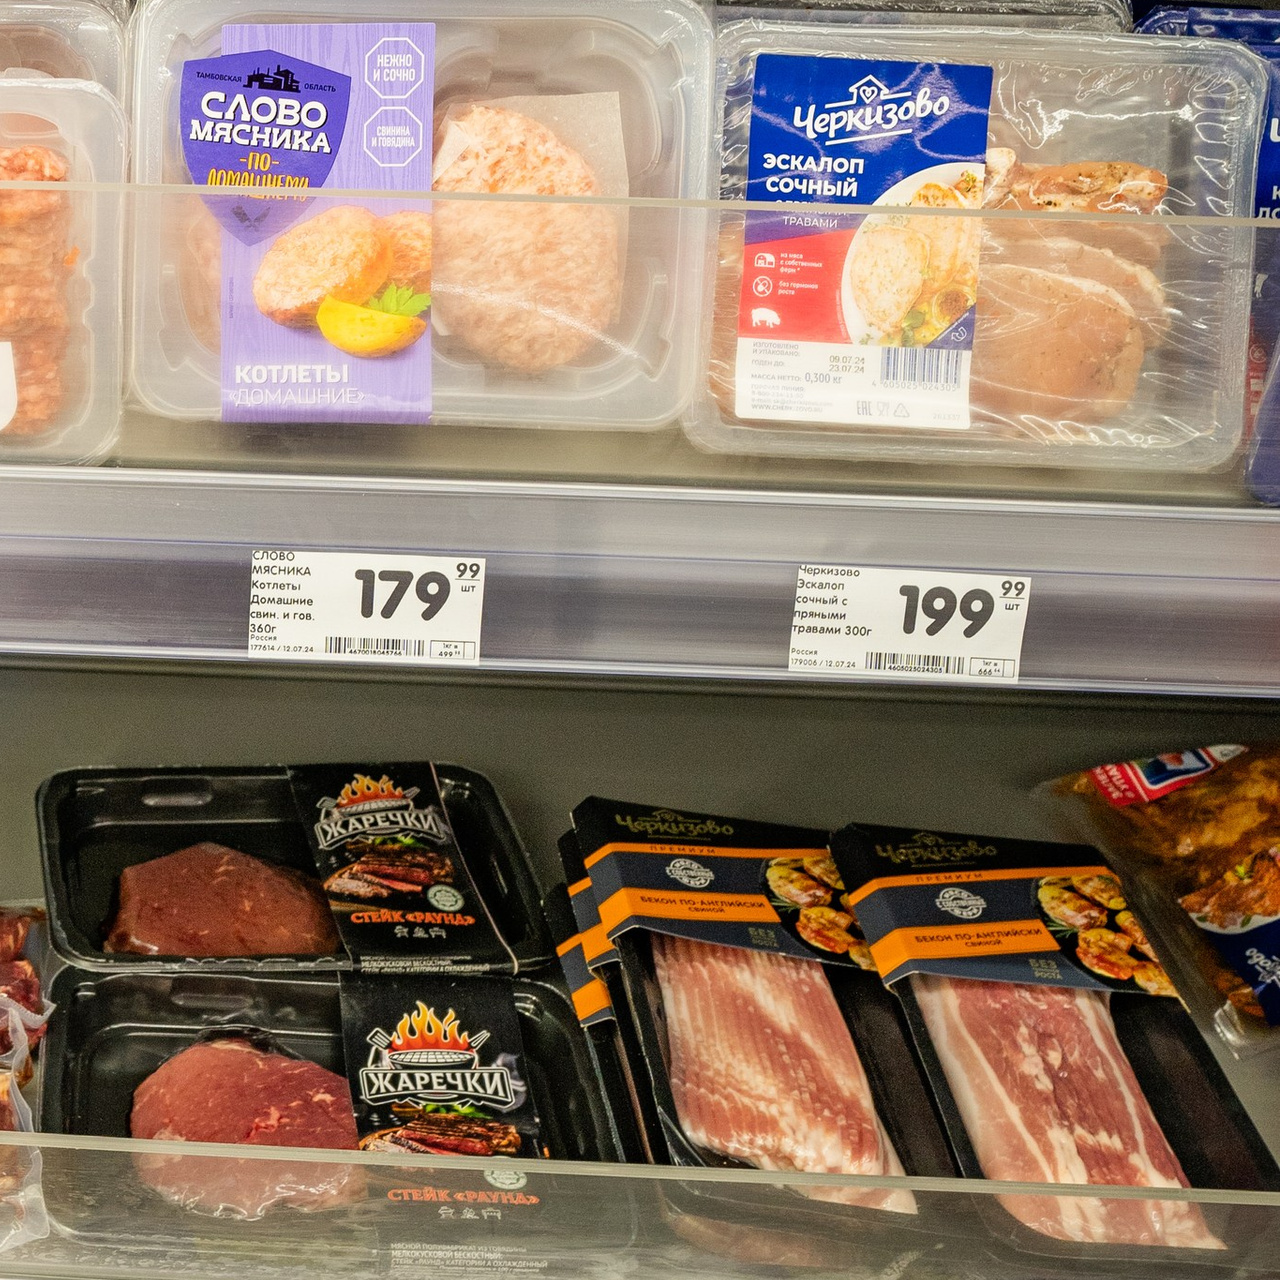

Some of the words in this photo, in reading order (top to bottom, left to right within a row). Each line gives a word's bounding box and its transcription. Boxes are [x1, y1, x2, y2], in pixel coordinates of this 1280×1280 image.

[377, 54, 413, 68] НЕЖНО
[196, 71, 242, 84] ТАМБОВСКАЯ
[383, 68, 416, 83] СОЧНО
[304, 82, 337, 93] ОБЛАСТЬ
[200, 91, 328, 128] СЛОВО
[793, 87, 950, 140] Черкизово
[190, 119, 332, 155] МЯСНИКА
[376, 125, 411, 137] СВИНИНА
[377, 136, 415, 148] ГОВЯДИНА
[762, 152, 865, 175] ЭСКАЛОП
[765, 176, 858, 197] СОЧНЫЙ
[783, 215, 838, 230] ТРАВАМИ
[235, 364, 350, 385] КОТЛЕТЫ
[229, 386, 365, 407] «ДОМАШНИЕ»
[253, 551, 295, 561] СЛОВО
[252, 565, 311, 576] МЯСНИКА
[799, 565, 860, 577] Черкизово
[251, 581, 301, 591] Котлеты
[355, 569, 451, 621] 179
[456, 563, 480, 578] 99
[461, 584, 476, 593] шт
[797, 579, 845, 591] Эскалоп
[251, 595, 314, 606] Домашние
[796, 595, 838, 606] сочный
[1005, 603, 1020, 612] шт
[794, 610, 846, 621] пряными
[899, 585, 995, 638] 199
[1001, 580, 1026, 597] 99
[250, 624, 277, 634] 360г
[792, 624, 841, 636] травами
[845, 626, 872, 637] 300г
[321, 812, 439, 841] ЖАРЕЧКИ
[615, 814, 734, 836] Черкизово
[640, 896, 676, 905] БЕКОН
[680, 898, 765, 909] ПО-АНГЛИЙСКИ
[350, 909, 405, 923] СТЕЙК
[915, 934, 952, 943] БЕКОН
[955, 928, 1042, 941] ПО-АНГЛИЙСКИ
[366, 1069, 509, 1097] ЖАРЕЧКИ
[387, 1186, 450, 1202] СТЕЙК
[454, 1190, 540, 1205] «РАУНД»
